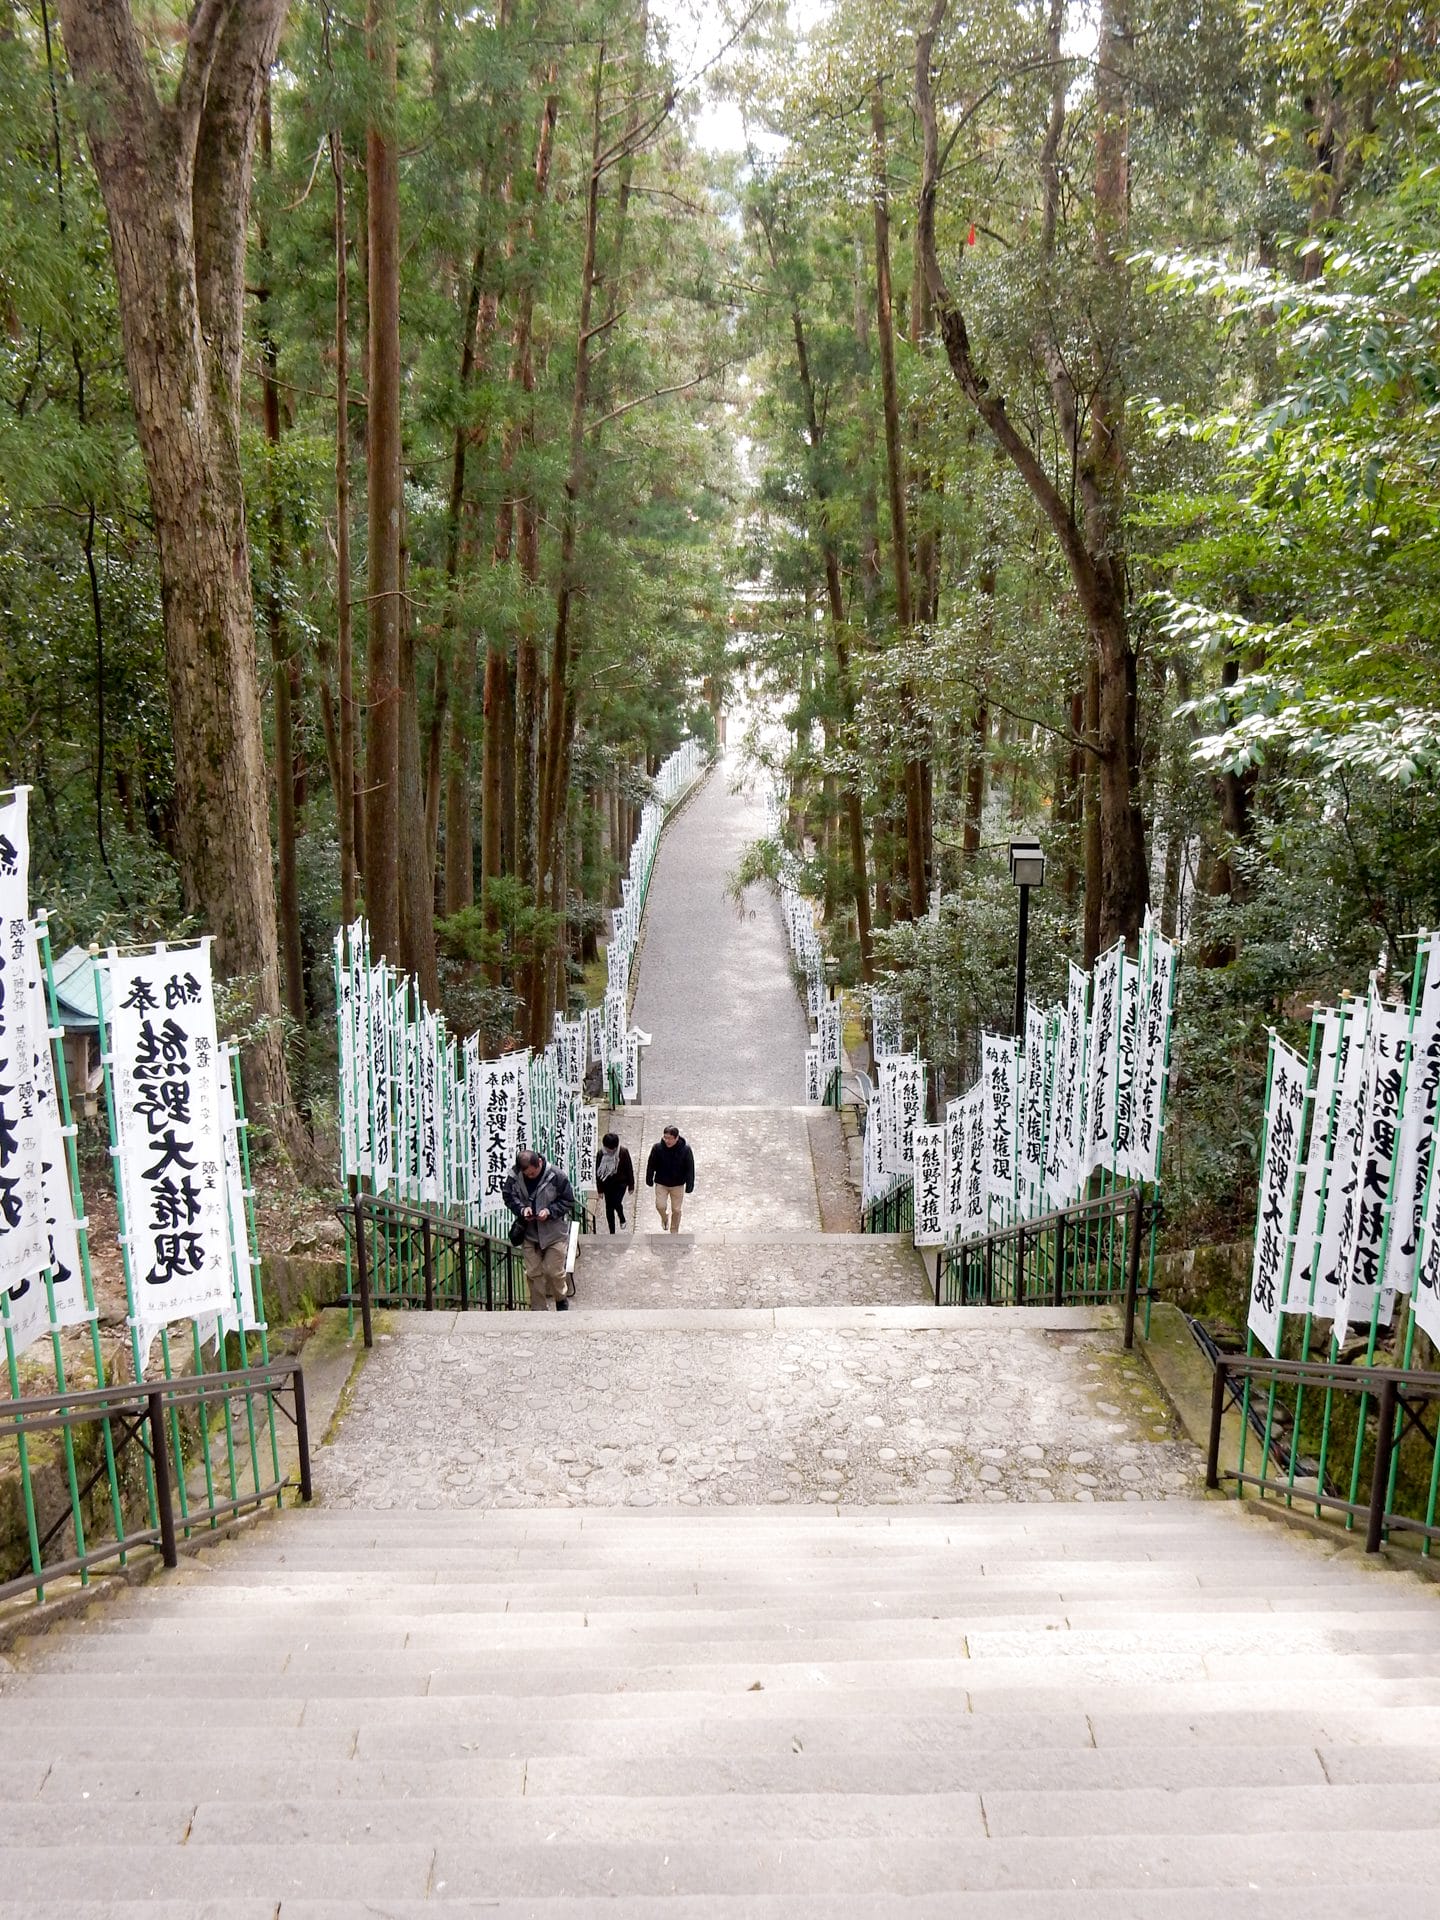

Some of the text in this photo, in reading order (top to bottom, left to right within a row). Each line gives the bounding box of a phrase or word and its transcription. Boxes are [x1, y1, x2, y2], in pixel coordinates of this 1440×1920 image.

[991, 1066, 1012, 1181] 熊野大権現
[1025, 1042, 1043, 1166] 熊野大権現
[921, 1148, 942, 1233] 熊野大権現
[968, 1117, 984, 1220] 熊野大権現
